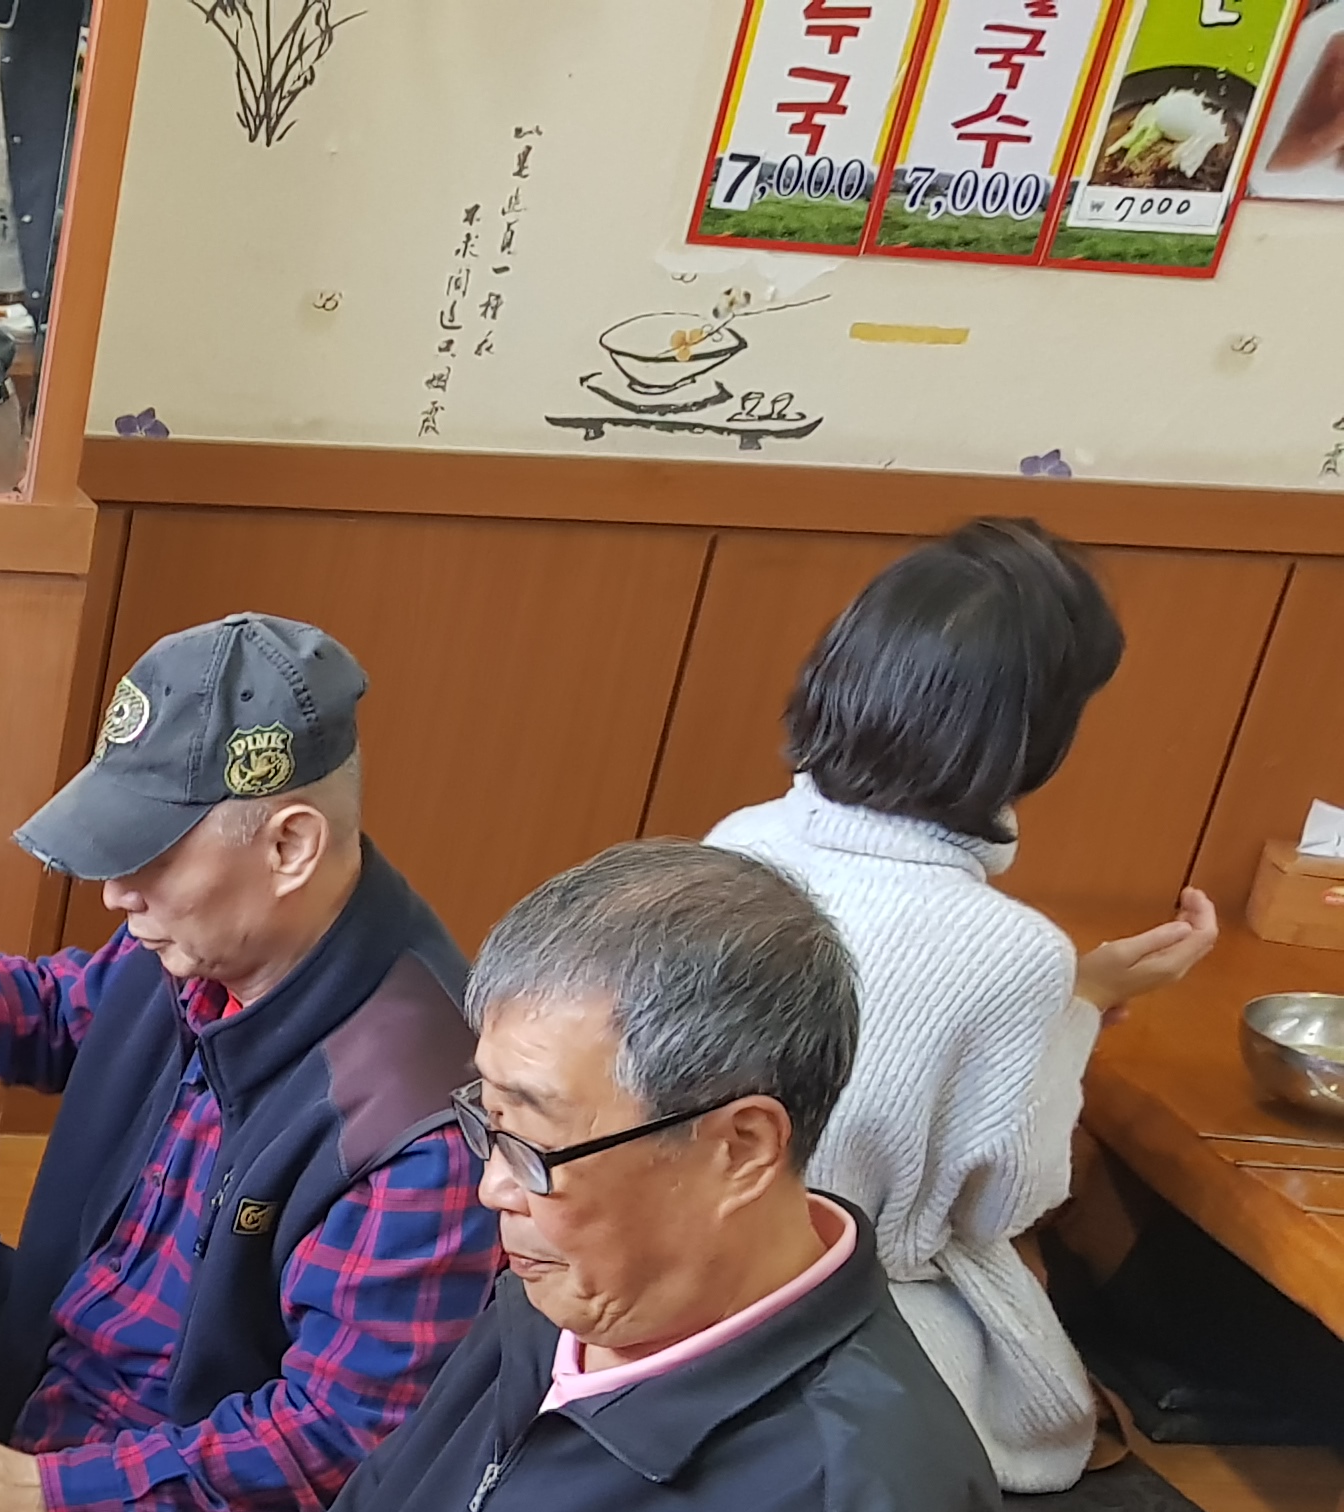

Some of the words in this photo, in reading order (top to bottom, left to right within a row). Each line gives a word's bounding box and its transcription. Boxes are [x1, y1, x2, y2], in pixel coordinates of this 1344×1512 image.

[951, 0, 1058, 169] 국수
[723, 153, 865, 201] 7,000
[908, 167, 1040, 216] 7,000
[231, 732, 288, 756] PINK
